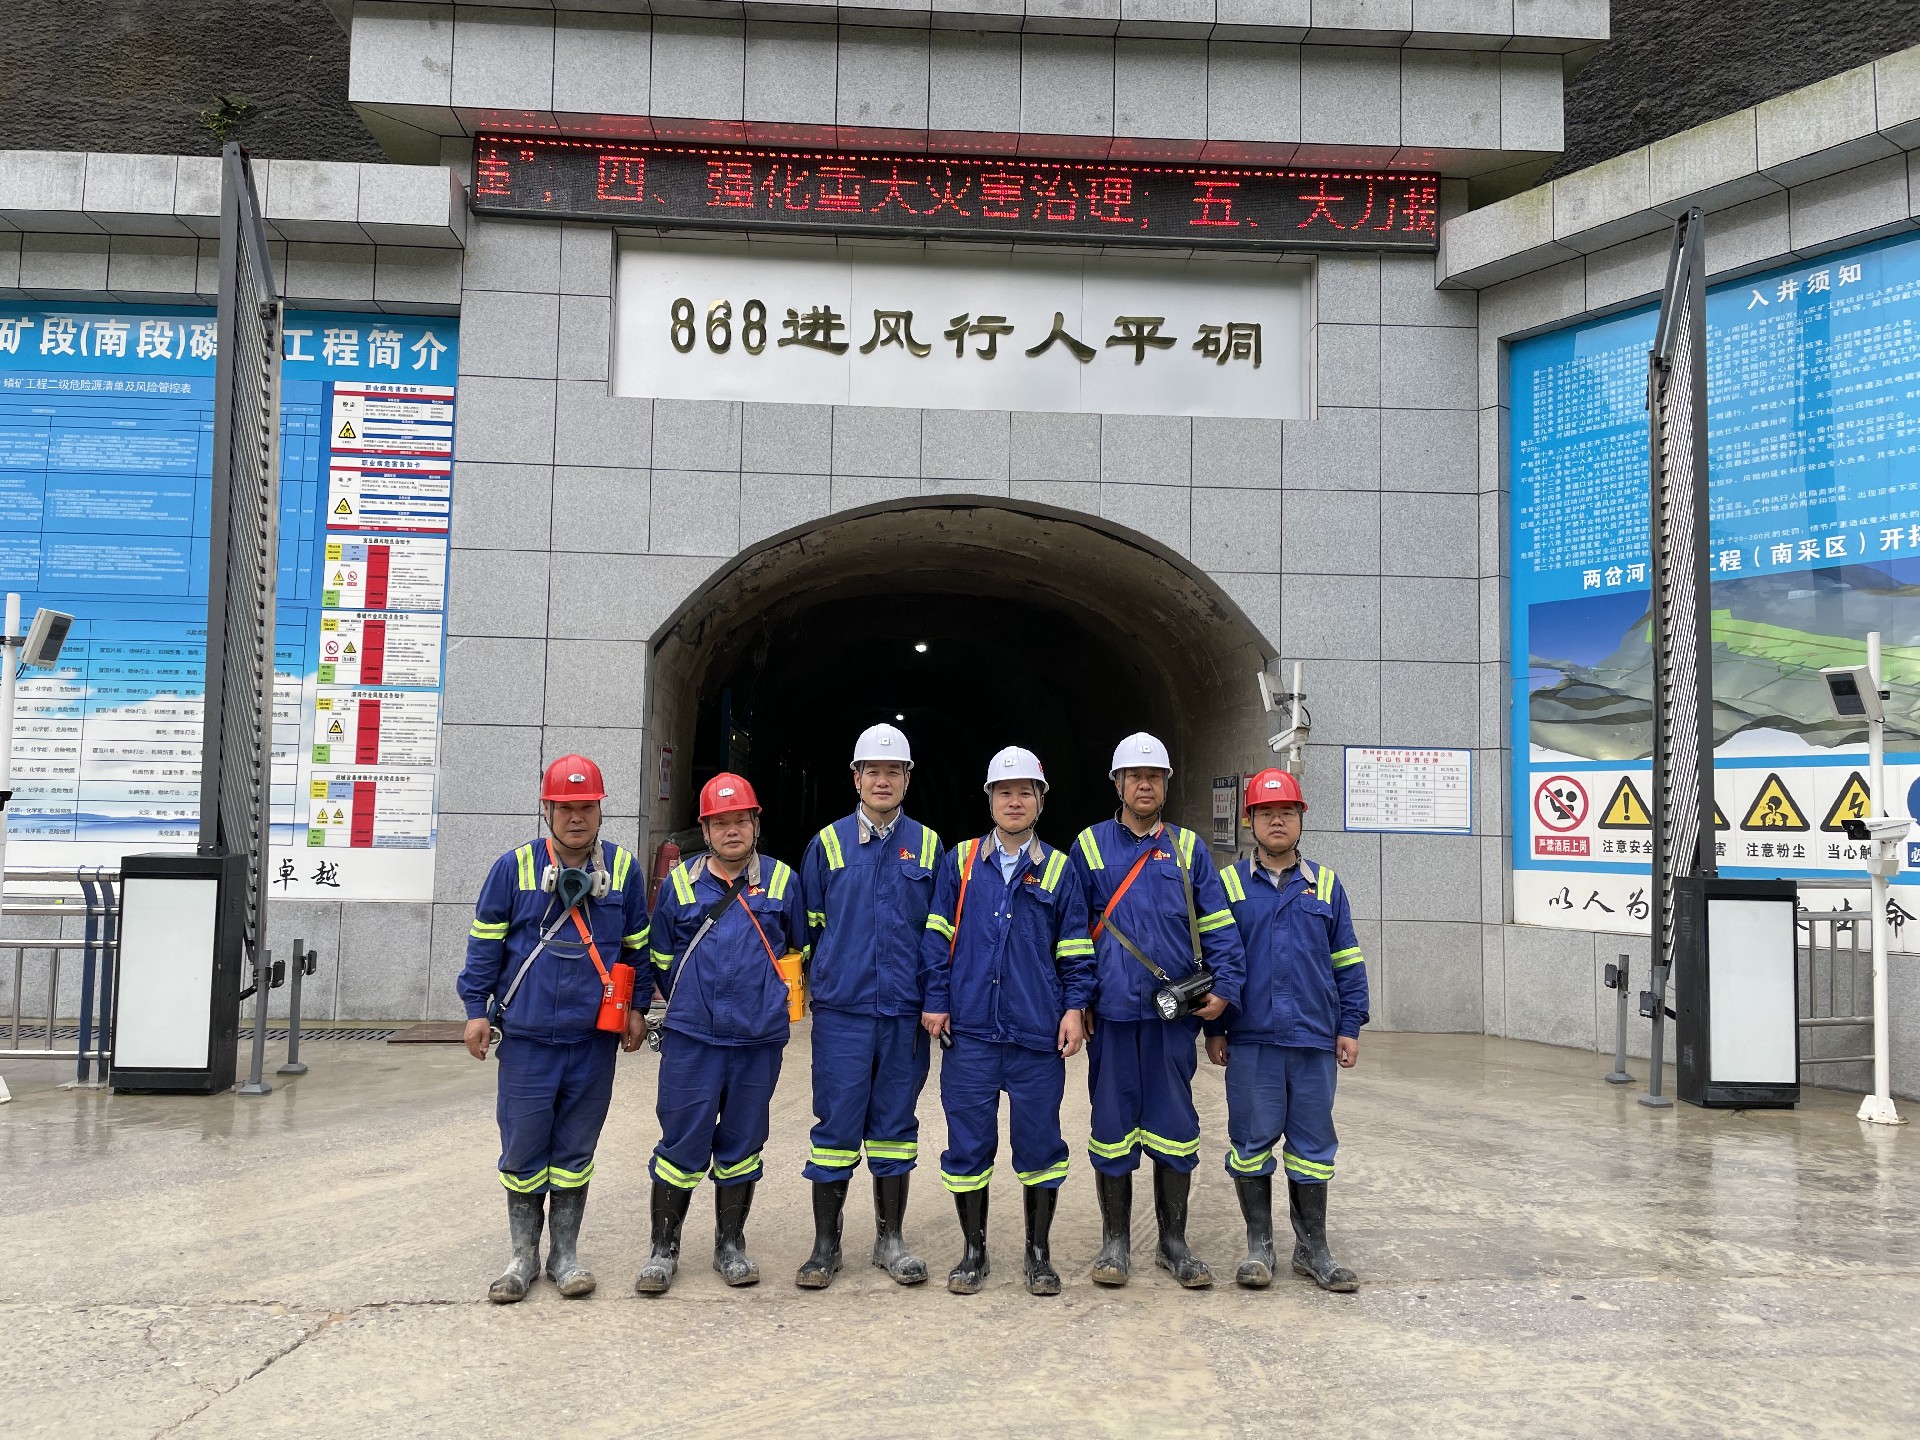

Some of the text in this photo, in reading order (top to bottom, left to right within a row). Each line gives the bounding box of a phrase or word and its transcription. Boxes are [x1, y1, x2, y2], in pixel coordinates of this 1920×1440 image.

[1747, 263, 1862, 311] 入井须知
[669, 298, 1263, 369] 868进风行人平硐
[282, 327, 448, 371] 工程简介
[3, 377, 192, 394] 磷矿工程二级危险源清单及风险管控表
[1583, 563, 1646, 589] 两岔河
[1538, 838, 1588, 854] 严禁酒后上岗
[1603, 839, 1652, 854] 注意安全
[1746, 843, 1806, 858] 注意粉尘
[273, 859, 340, 891] 卓越
